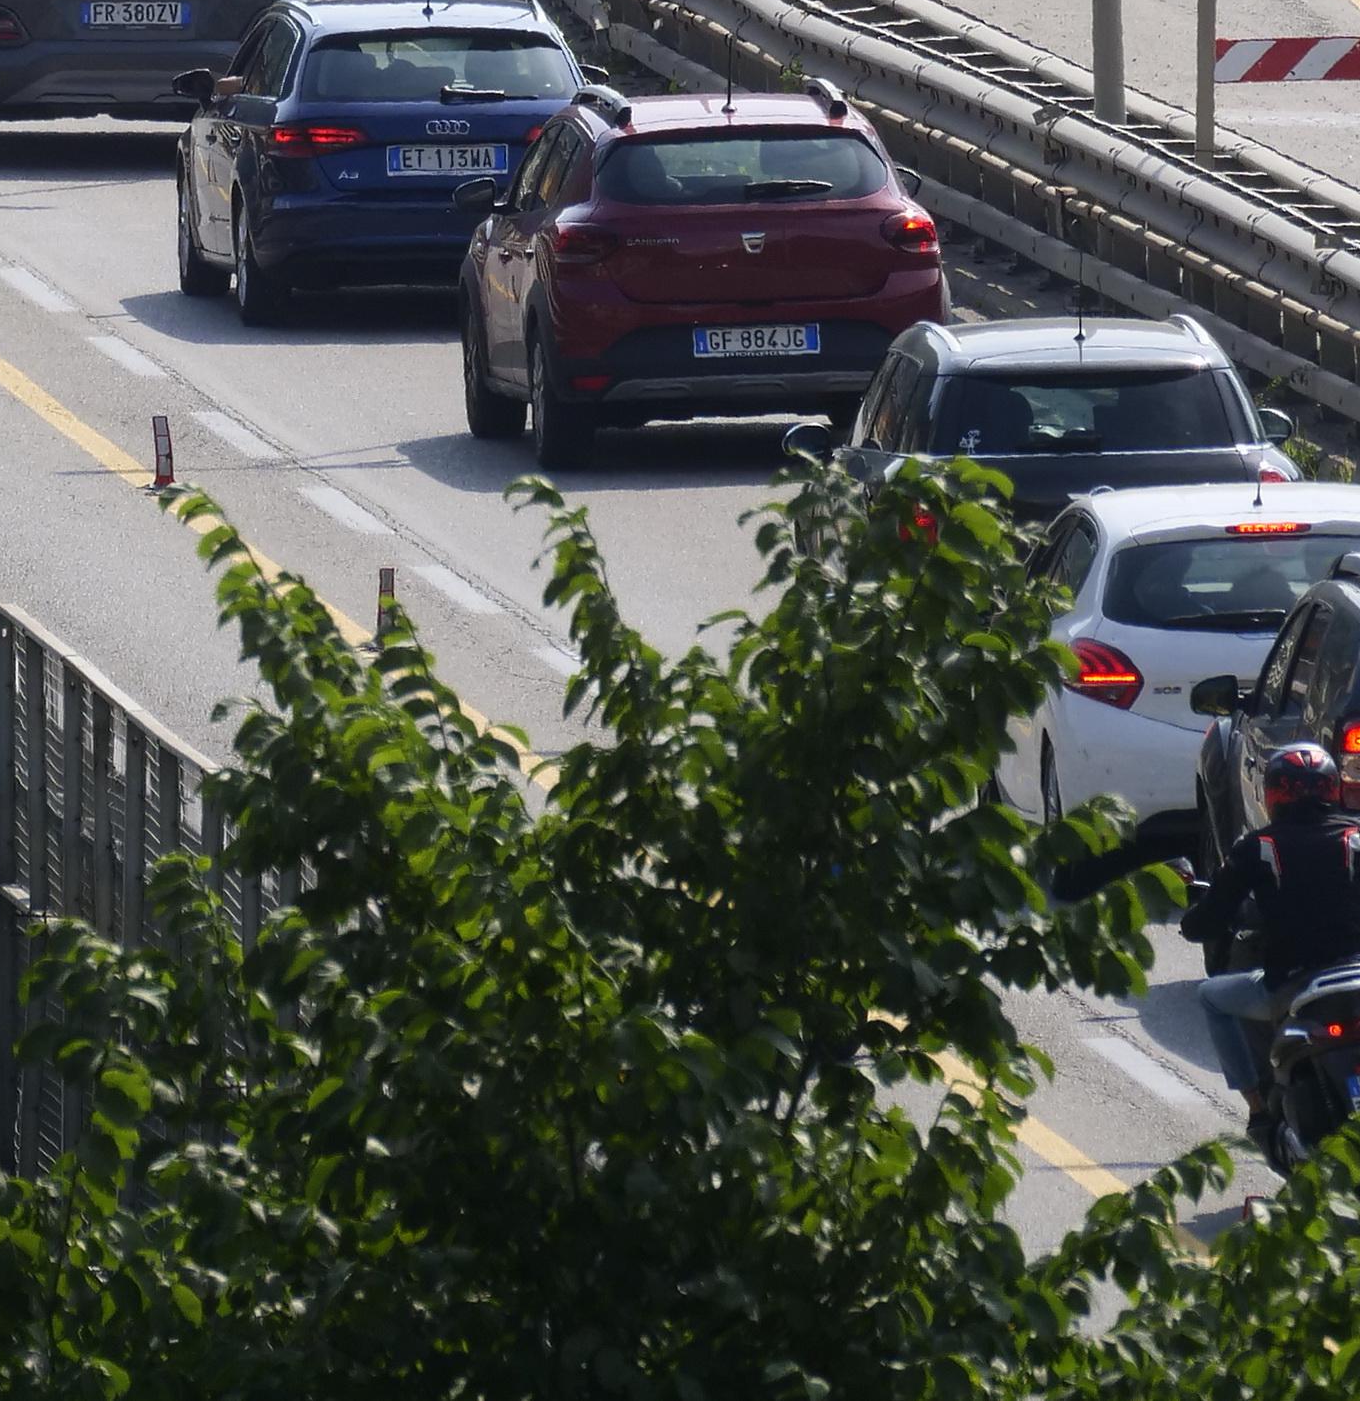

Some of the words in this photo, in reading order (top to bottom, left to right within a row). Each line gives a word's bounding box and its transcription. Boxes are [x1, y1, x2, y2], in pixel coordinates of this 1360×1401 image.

[92, 3, 115, 23] FR
[122, 3, 179, 23] 380ZV
[401, 149, 425, 168] ET
[709, 330, 733, 351] GF
[740, 329, 805, 349] 884JG
